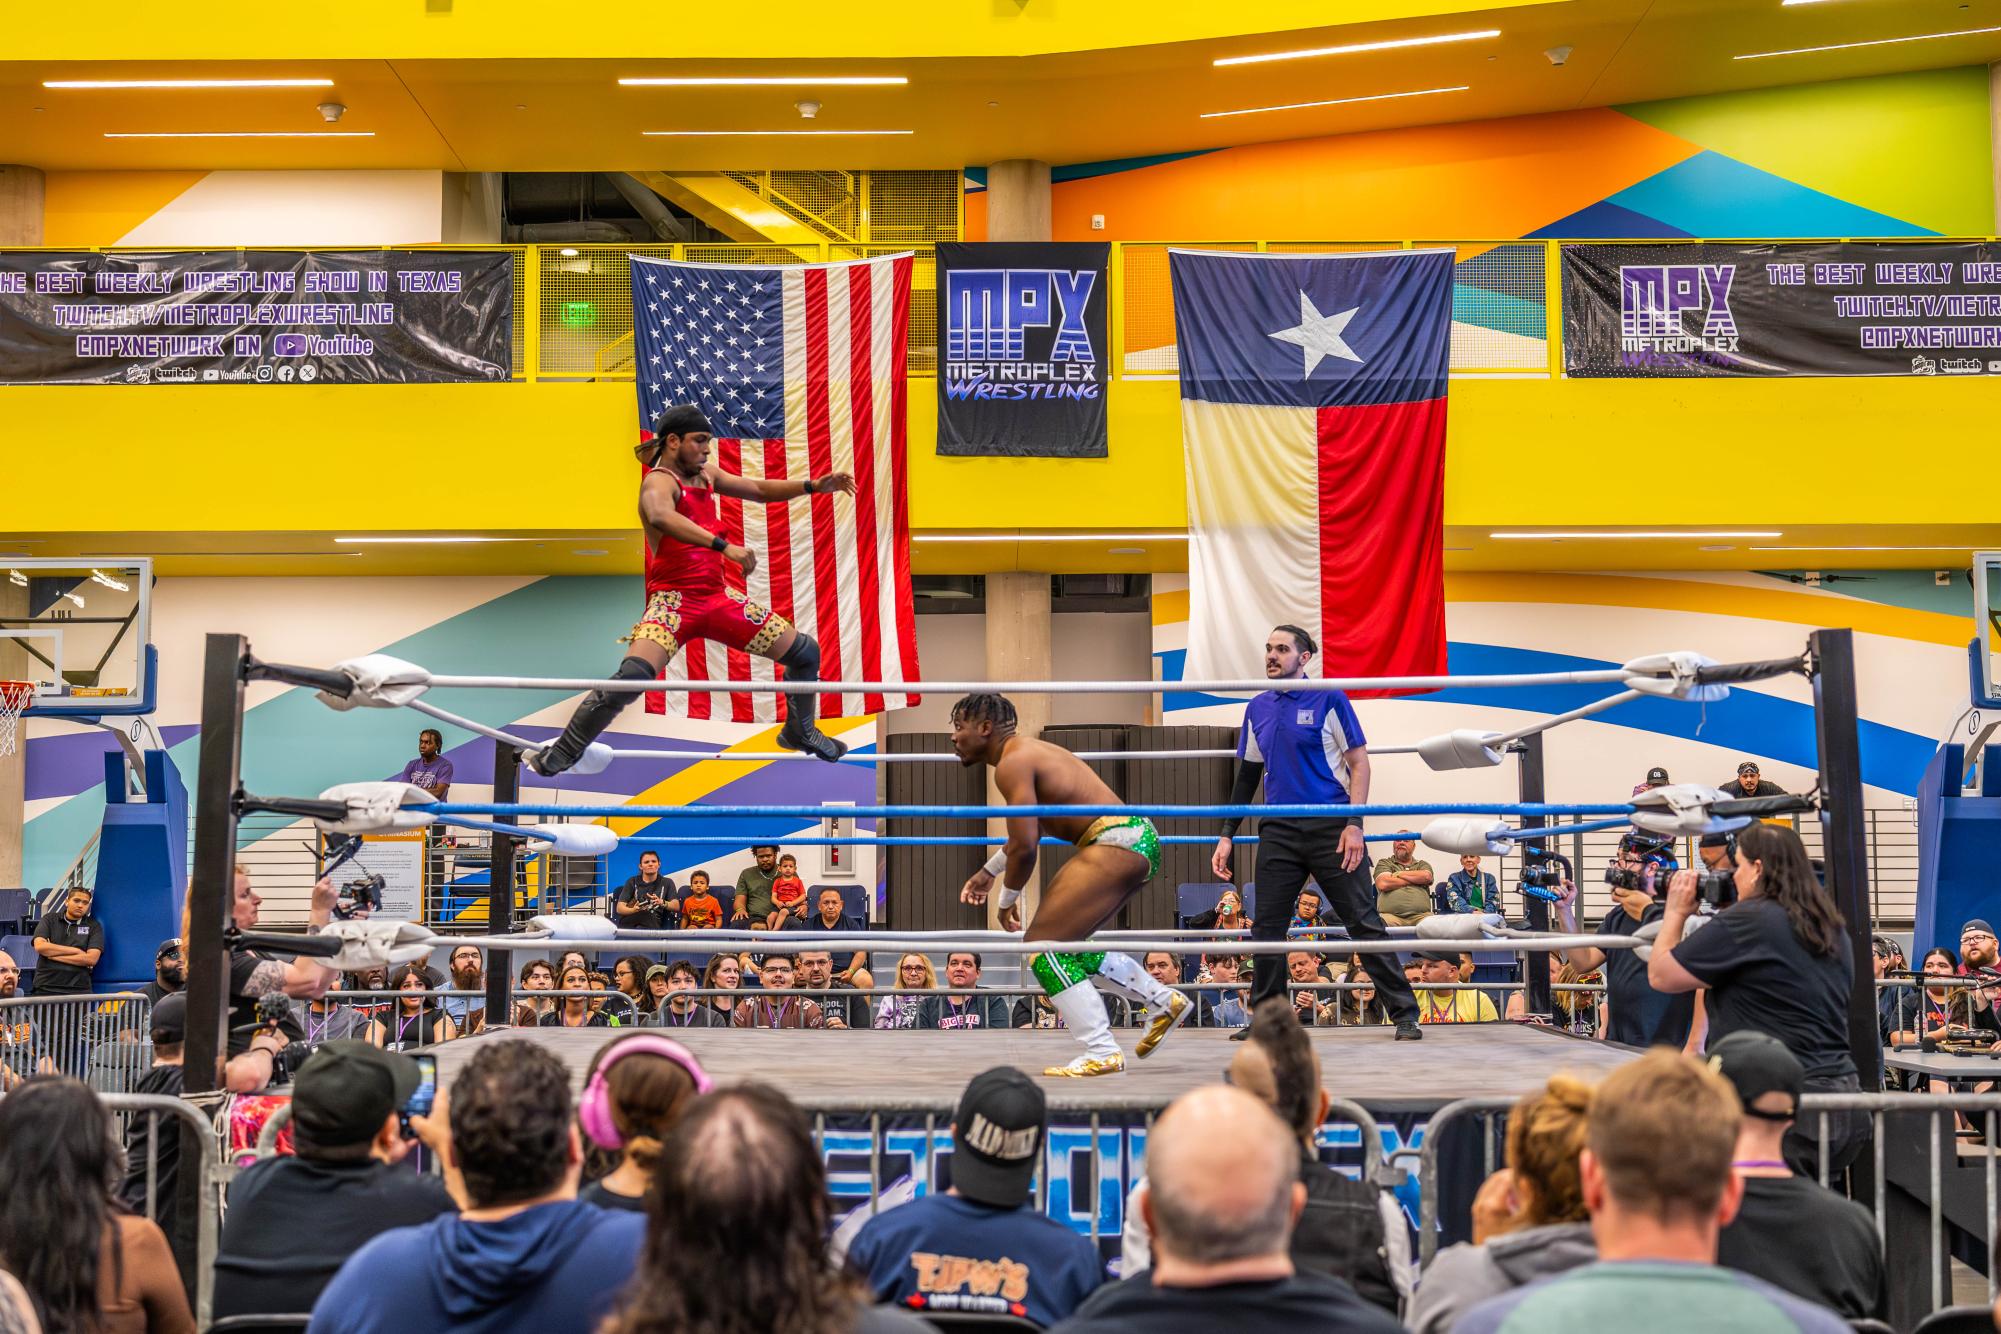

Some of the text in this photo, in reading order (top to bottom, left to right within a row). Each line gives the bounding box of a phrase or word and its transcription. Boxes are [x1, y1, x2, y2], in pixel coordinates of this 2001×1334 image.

[35, 272, 86, 294] BEST
[96, 272, 174, 294] WEEKLY
[184, 271, 296, 294] WRESTLING
[305, 271, 359, 293] SHOW
[368, 271, 387, 293] IN
[397, 271, 461, 293] TEXAS
[1766, 263, 1805, 285] THE
[1814, 263, 1866, 285] BEST
[1875, 263, 1953, 284] WEEKLY
[1620, 265, 1739, 337] MPX
[53, 303, 394, 326] TWITCH.TV/METROPLEXWRESTLING
[946, 269, 1098, 362] MPX
[234, 334, 261, 357] ON
[308, 334, 373, 356] YouTube
[1621, 337, 1740, 352] METROPLEX
[155, 366, 197, 381] twitch
[220, 370, 251, 380] YouTube
[946, 362, 1096, 382] METROPLEX
[1940, 358, 1982, 373] twitch
